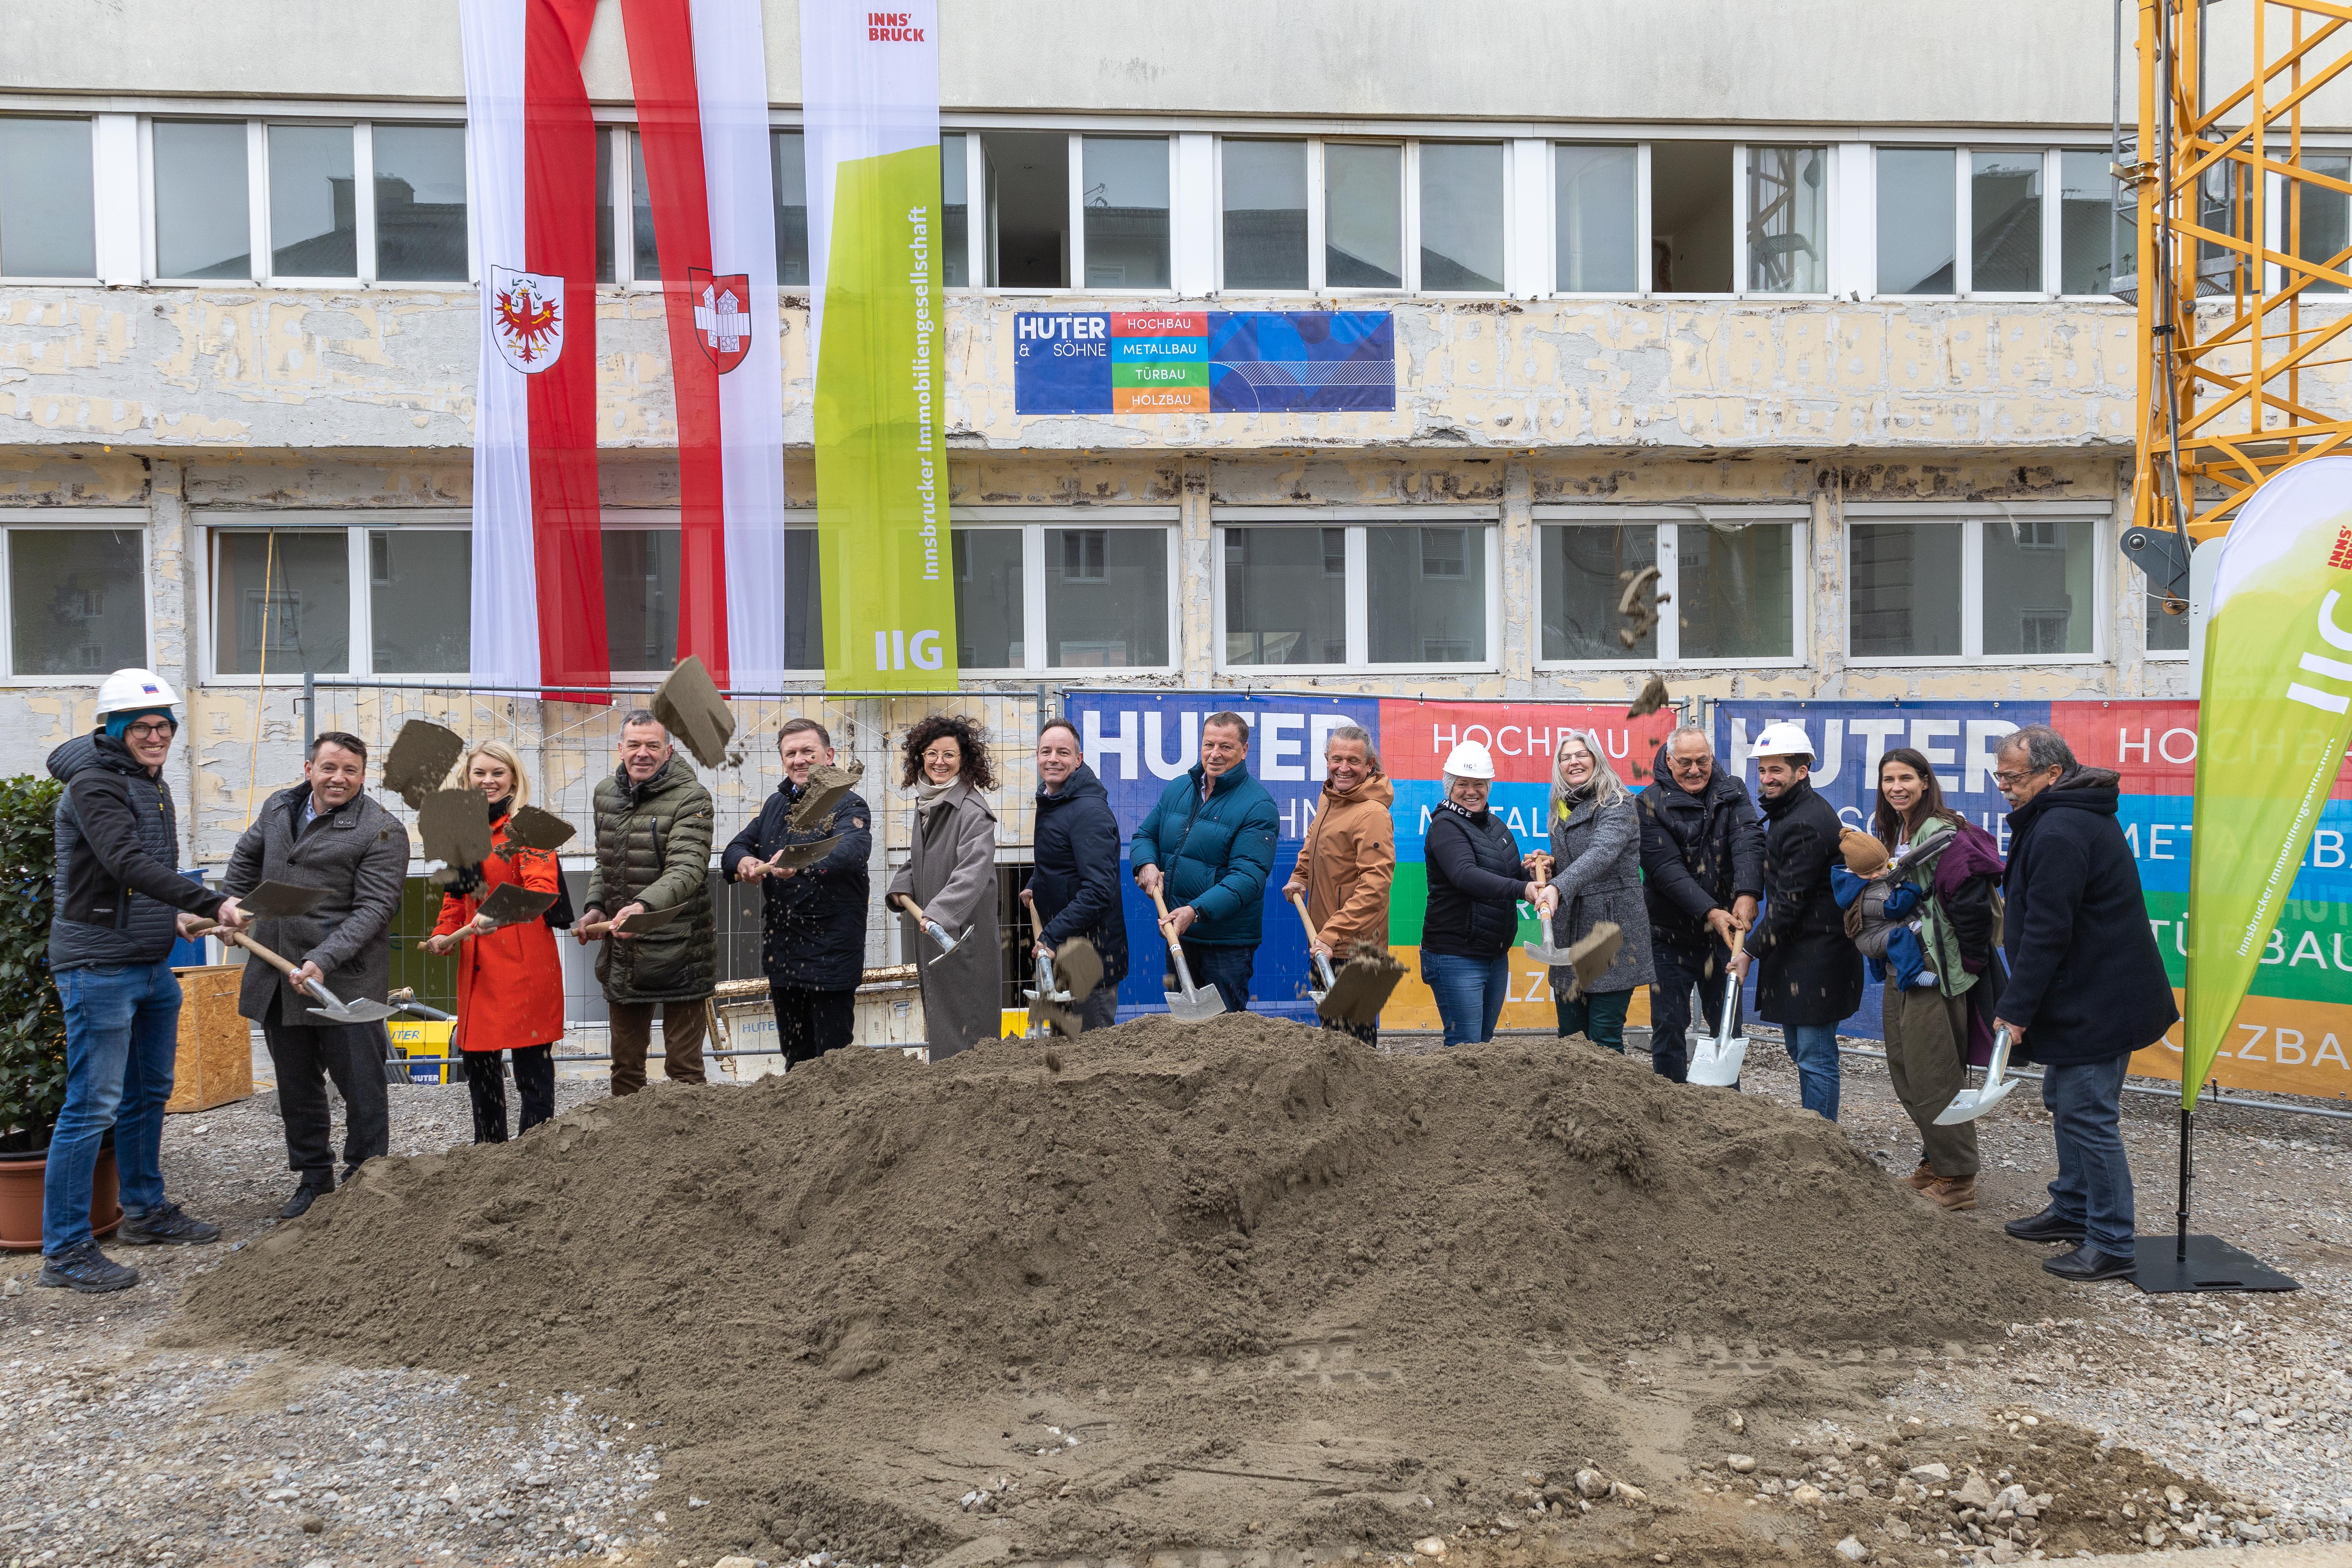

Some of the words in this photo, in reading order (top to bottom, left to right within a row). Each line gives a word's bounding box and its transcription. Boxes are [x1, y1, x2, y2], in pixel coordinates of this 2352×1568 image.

[868, 13, 912, 27] INNS'
[868, 28, 925, 42] BRUCK
[907, 206, 934, 452] Immobiliengesellschaft
[1020, 317, 1106, 339] HUTER
[1127, 318, 1191, 330] HOCHBAU
[1020, 344, 1030, 357] &
[1053, 340, 1107, 357] SÖHNE
[1123, 343, 1196, 355] METALLBAU
[1135, 367, 1186, 380] TÜRBAU
[1132, 394, 1191, 406] HOLZBAU
[916, 457, 939, 580] Innsbrucker
[875, 630, 943, 671] IIG
[2237, 886, 2272, 957] Innsbrucker
[742, 1020, 779, 1033] HUTE
